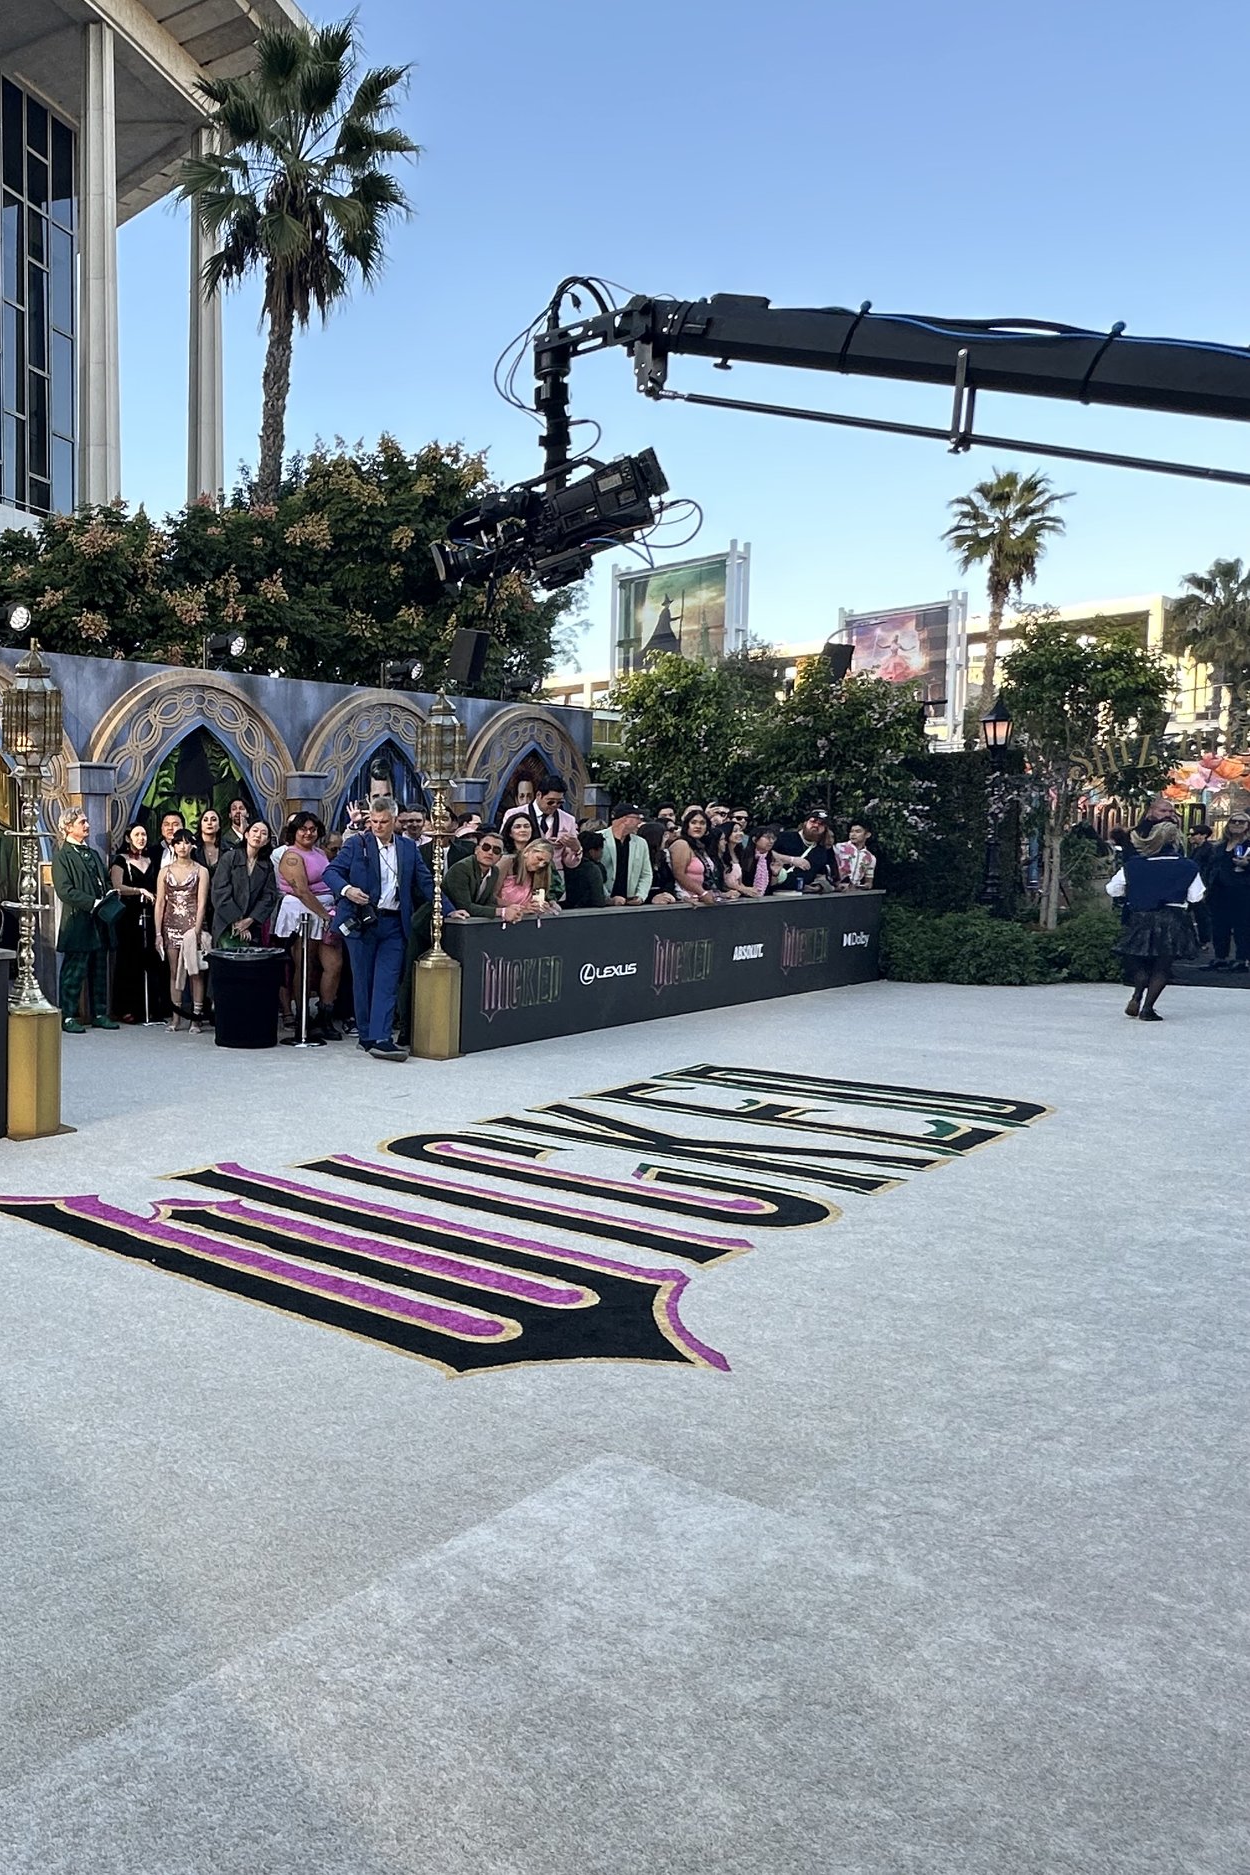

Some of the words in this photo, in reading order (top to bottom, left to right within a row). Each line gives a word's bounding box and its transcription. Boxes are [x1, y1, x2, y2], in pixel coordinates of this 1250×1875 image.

[480, 951, 563, 1023] WICKED
[596, 962, 638, 979] LEXUS
[651, 934, 714, 996] WICKED
